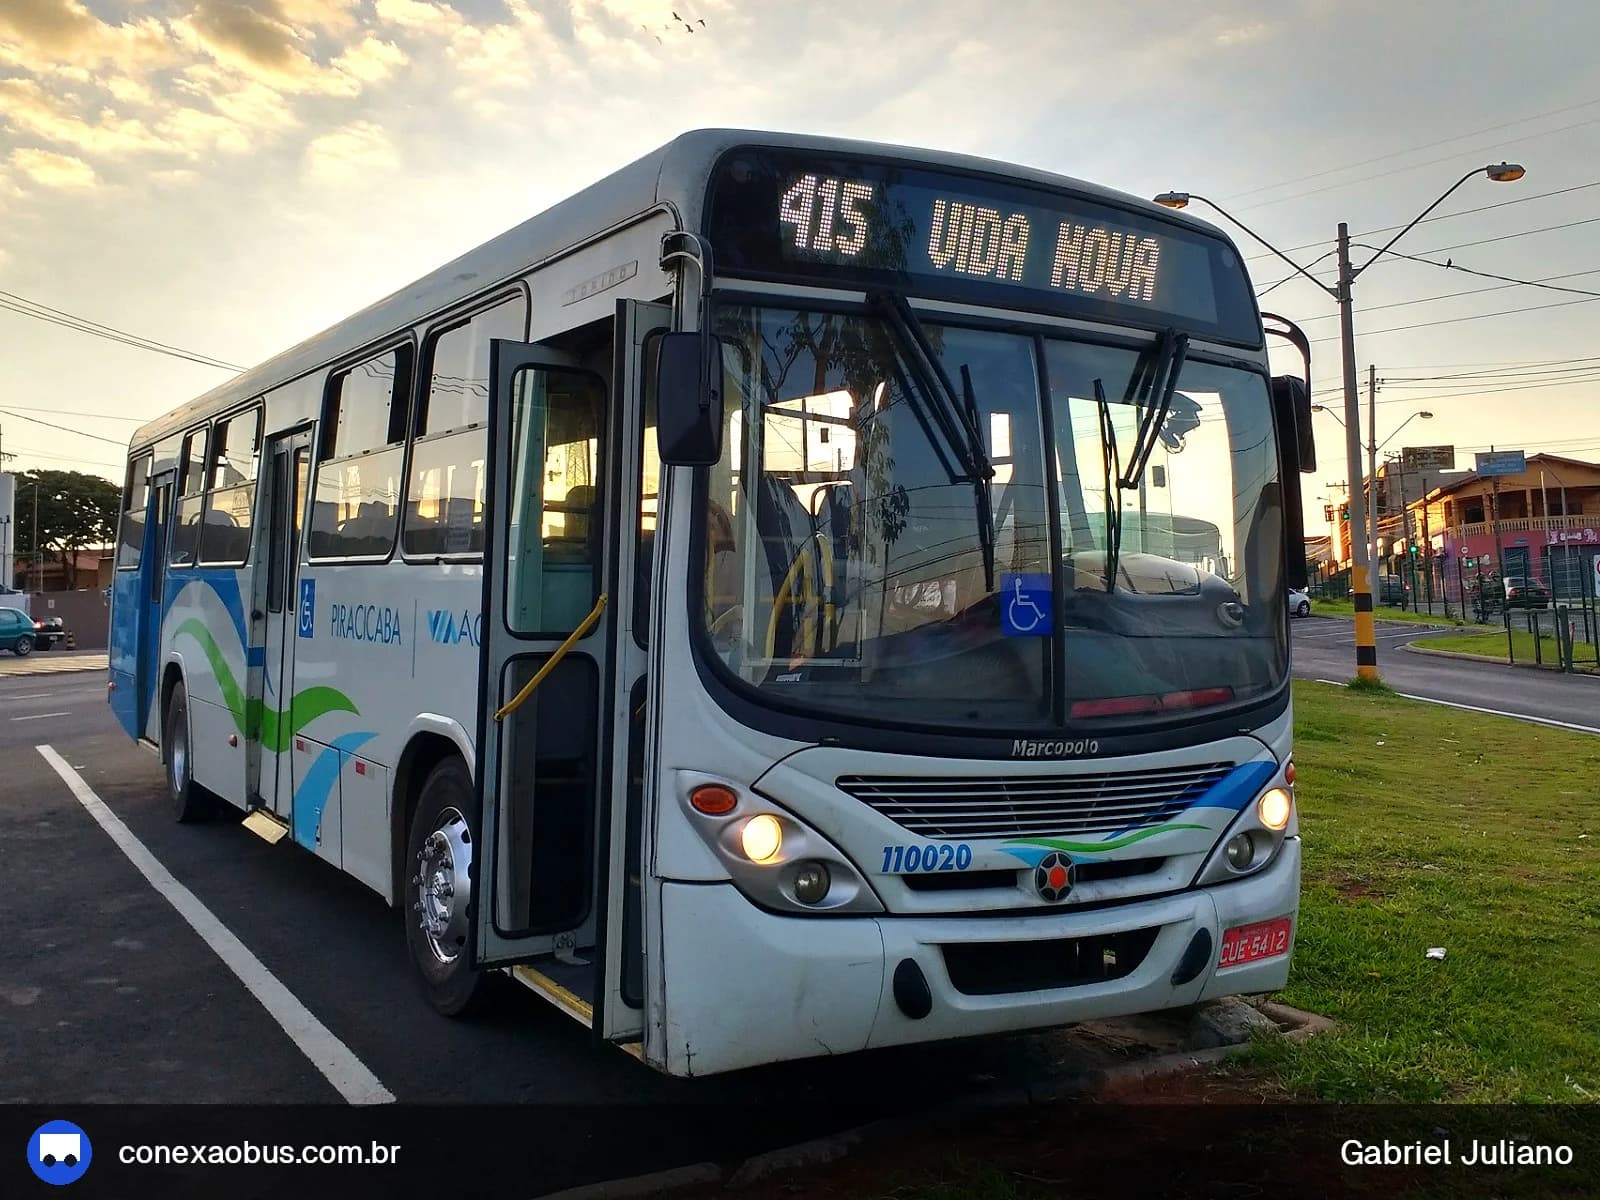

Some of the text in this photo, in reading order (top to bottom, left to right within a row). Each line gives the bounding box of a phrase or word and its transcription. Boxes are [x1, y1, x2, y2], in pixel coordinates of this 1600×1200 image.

[779, 174, 1160, 301] 415 VIDA NOVA
[331, 604, 402, 645] PIRACICABA
[1011, 738, 1099, 757] Marcopolo
[881, 844, 972, 873] 110020
